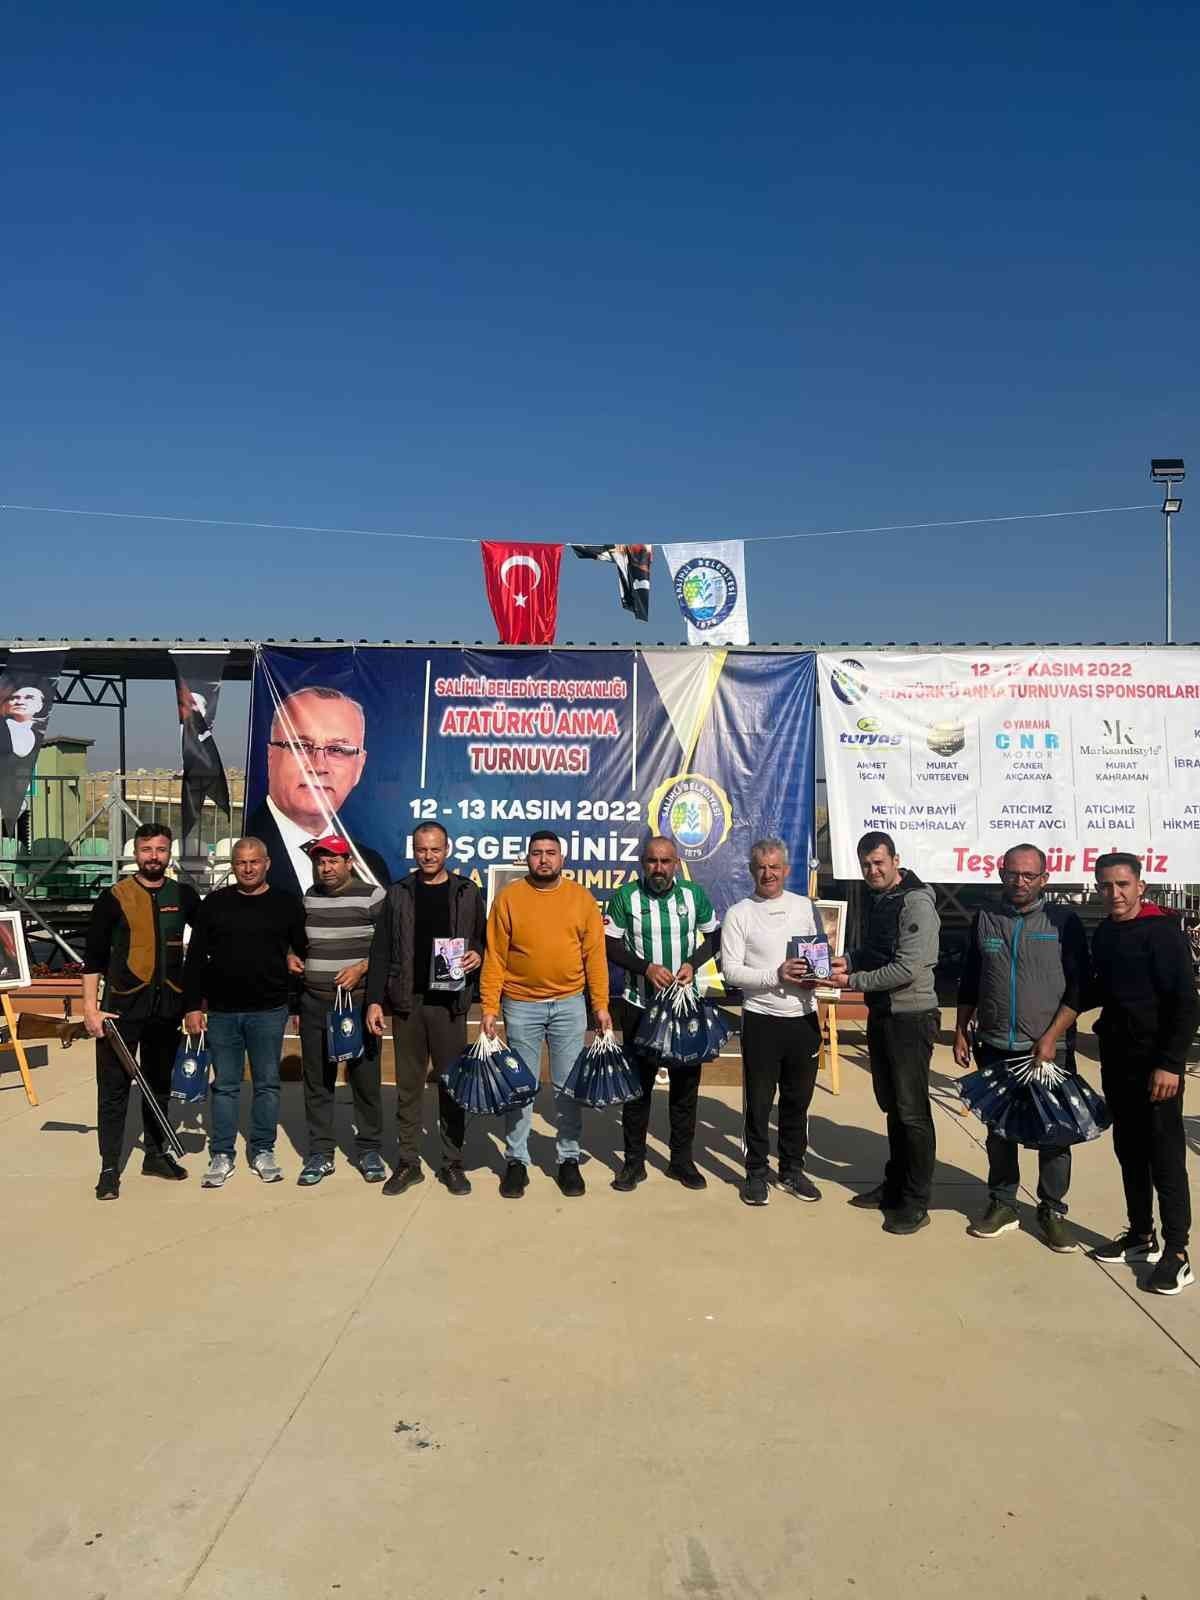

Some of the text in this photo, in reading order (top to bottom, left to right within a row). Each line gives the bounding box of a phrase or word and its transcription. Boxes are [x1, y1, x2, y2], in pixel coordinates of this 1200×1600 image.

[971, 663, 990, 677] 12
[1027, 663, 1083, 677] KASIM
[1089, 663, 1132, 677] 2022
[435, 675, 627, 703] SALİHLİ BELEDİYE BAŞKANLIĞI
[1008, 684, 1093, 698] TURNUVASI
[1096, 684, 1199, 699] SPONSORLARI
[440, 703, 620, 737] ATATÜRK'Ü ANMA
[1014, 720, 1050, 729] YAMAHA
[469, 746, 590, 774] TURNUVASI
[926, 762, 958, 770] MURAT
[1013, 762, 1043, 770] CANER
[916, 773, 969, 781] YURTSEVEN
[1096, 773, 1149, 781] KAHRAMAN
[410, 799, 437, 819] 12
[458, 799, 485, 820] 13
[491, 800, 571, 821] KASIM
[576, 801, 641, 821] 2022
[872, 803, 906, 815] METİN
[909, 805, 924, 815] AV
[1002, 805, 1053, 814] ATICIMIZ
[1085, 804, 1136, 814] ATICIMIZ
[863, 818, 966, 831] METİN DEMİRALAY
[989, 819, 1066, 829] SERHAT AVCI
[1087, 817, 1135, 829] ALİ BALİ
